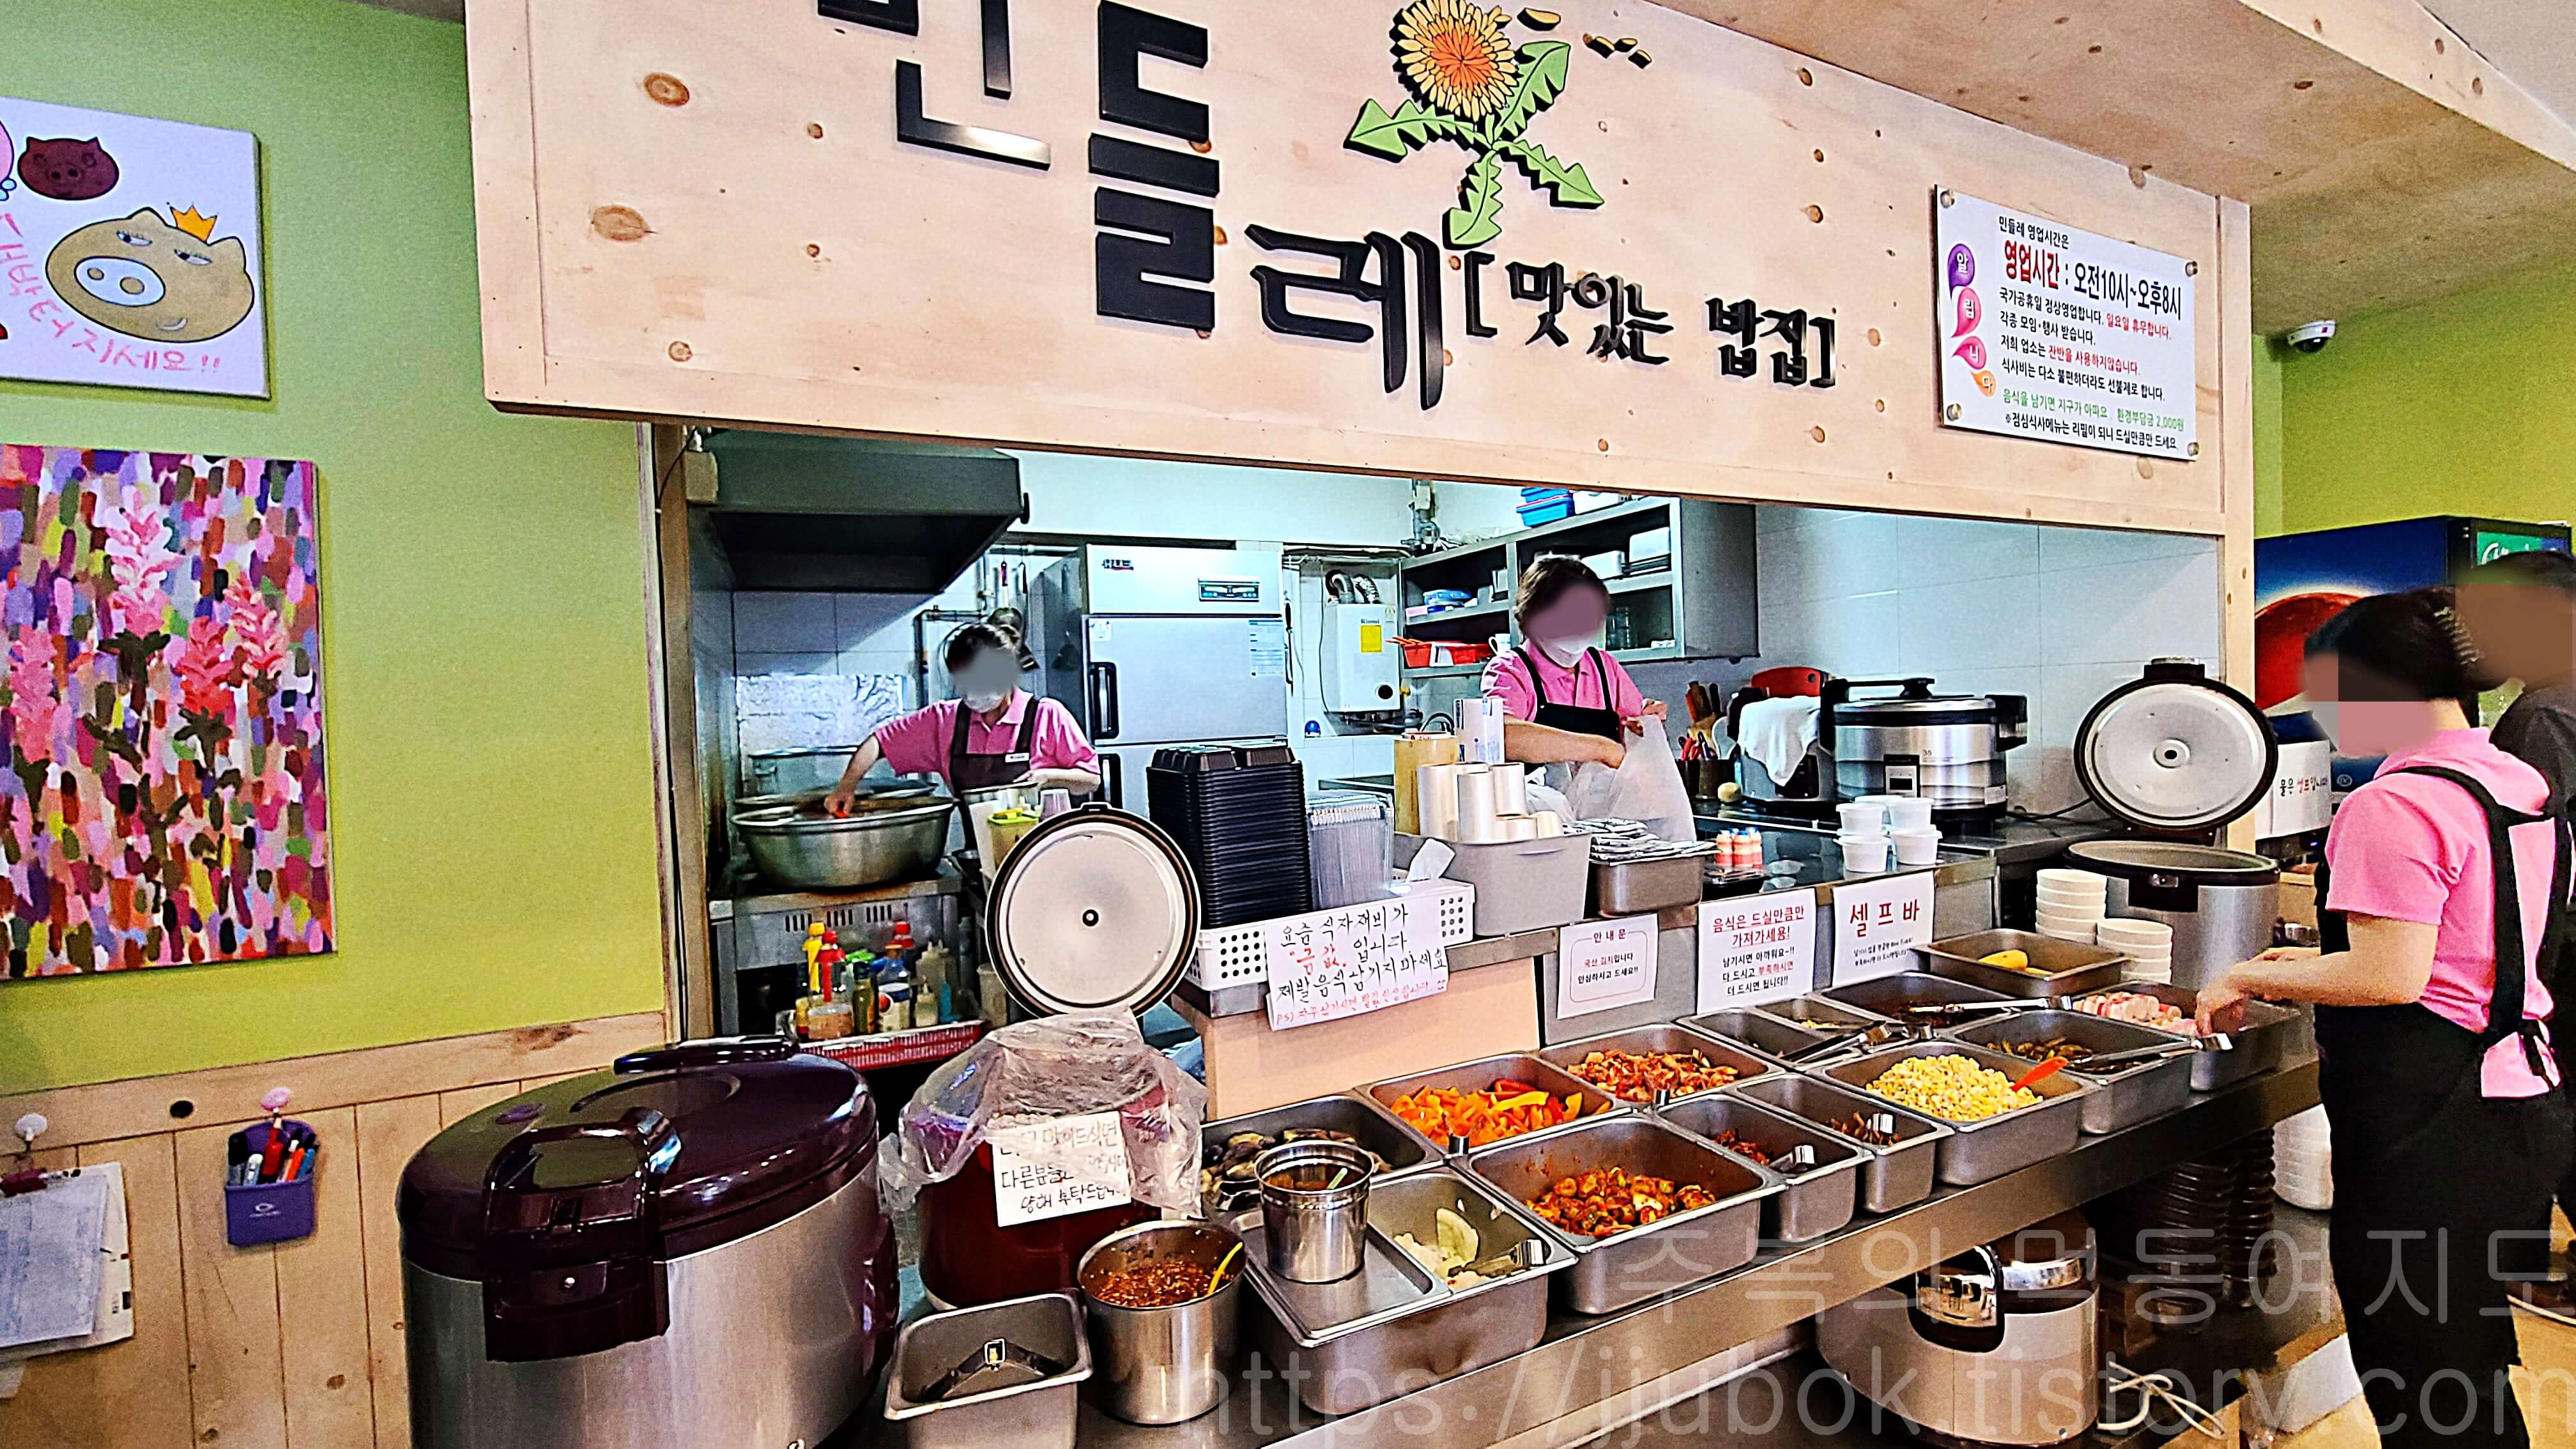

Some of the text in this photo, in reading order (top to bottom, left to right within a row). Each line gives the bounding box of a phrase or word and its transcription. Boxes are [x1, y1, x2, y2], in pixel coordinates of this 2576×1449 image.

[1999, 216, 2069, 249] 민들레 영업시간은
[2004, 240, 2060, 289] 영업시간
[2074, 263, 2181, 321] 오전10시~오후8시
[1999, 288, 2042, 311] 국가공휴일
[2045, 298, 2104, 325] 정상영업합니다.
[2106, 313, 2129, 331] 일요일
[2000, 310, 2018, 328] 각종
[2061, 325, 2096, 346] 받습니다.
[2001, 335, 2018, 352] 저희
[2021, 339, 2046, 357] 업소는
[2049, 345, 2073, 363] 잔반을
[2002, 358, 2035, 378] 식사비는
[2039, 365, 2055, 380] 다소
[2058, 369, 2106, 390] 불편하더라도
[2108, 379, 2138, 395] 선불제로
[2003, 388, 2028, 407] 음식을
[2031, 394, 2055, 411] 남기면
[2058, 399, 2082, 415] 지구가
[2073, 422, 2096, 439] 리필이
[2098, 426, 2113, 441] 되니
[2116, 429, 2153, 447] 드실만큼만
[1713, 905, 1804, 933] 음식은 드실만큼만
[1281, 922, 1314, 948] 요즘
[1353, 931, 1407, 963] 입니다
[1732, 925, 1790, 948] 가져가세용!
[1722, 953, 1752, 968] 남기시면
[1722, 960, 1793, 982] 다 드시고 부족하시면
[1276, 976, 1310, 1004] 제발
[1313, 969, 1347, 997] 음식
[1400, 949, 1447, 976] 마세요
[1578, 970, 1611, 985] 안심하시고
[1728, 986, 1735, 995] 더
[1737, 981, 1759, 994] 드시면
[1021, 1194, 1052, 1214] 양해
